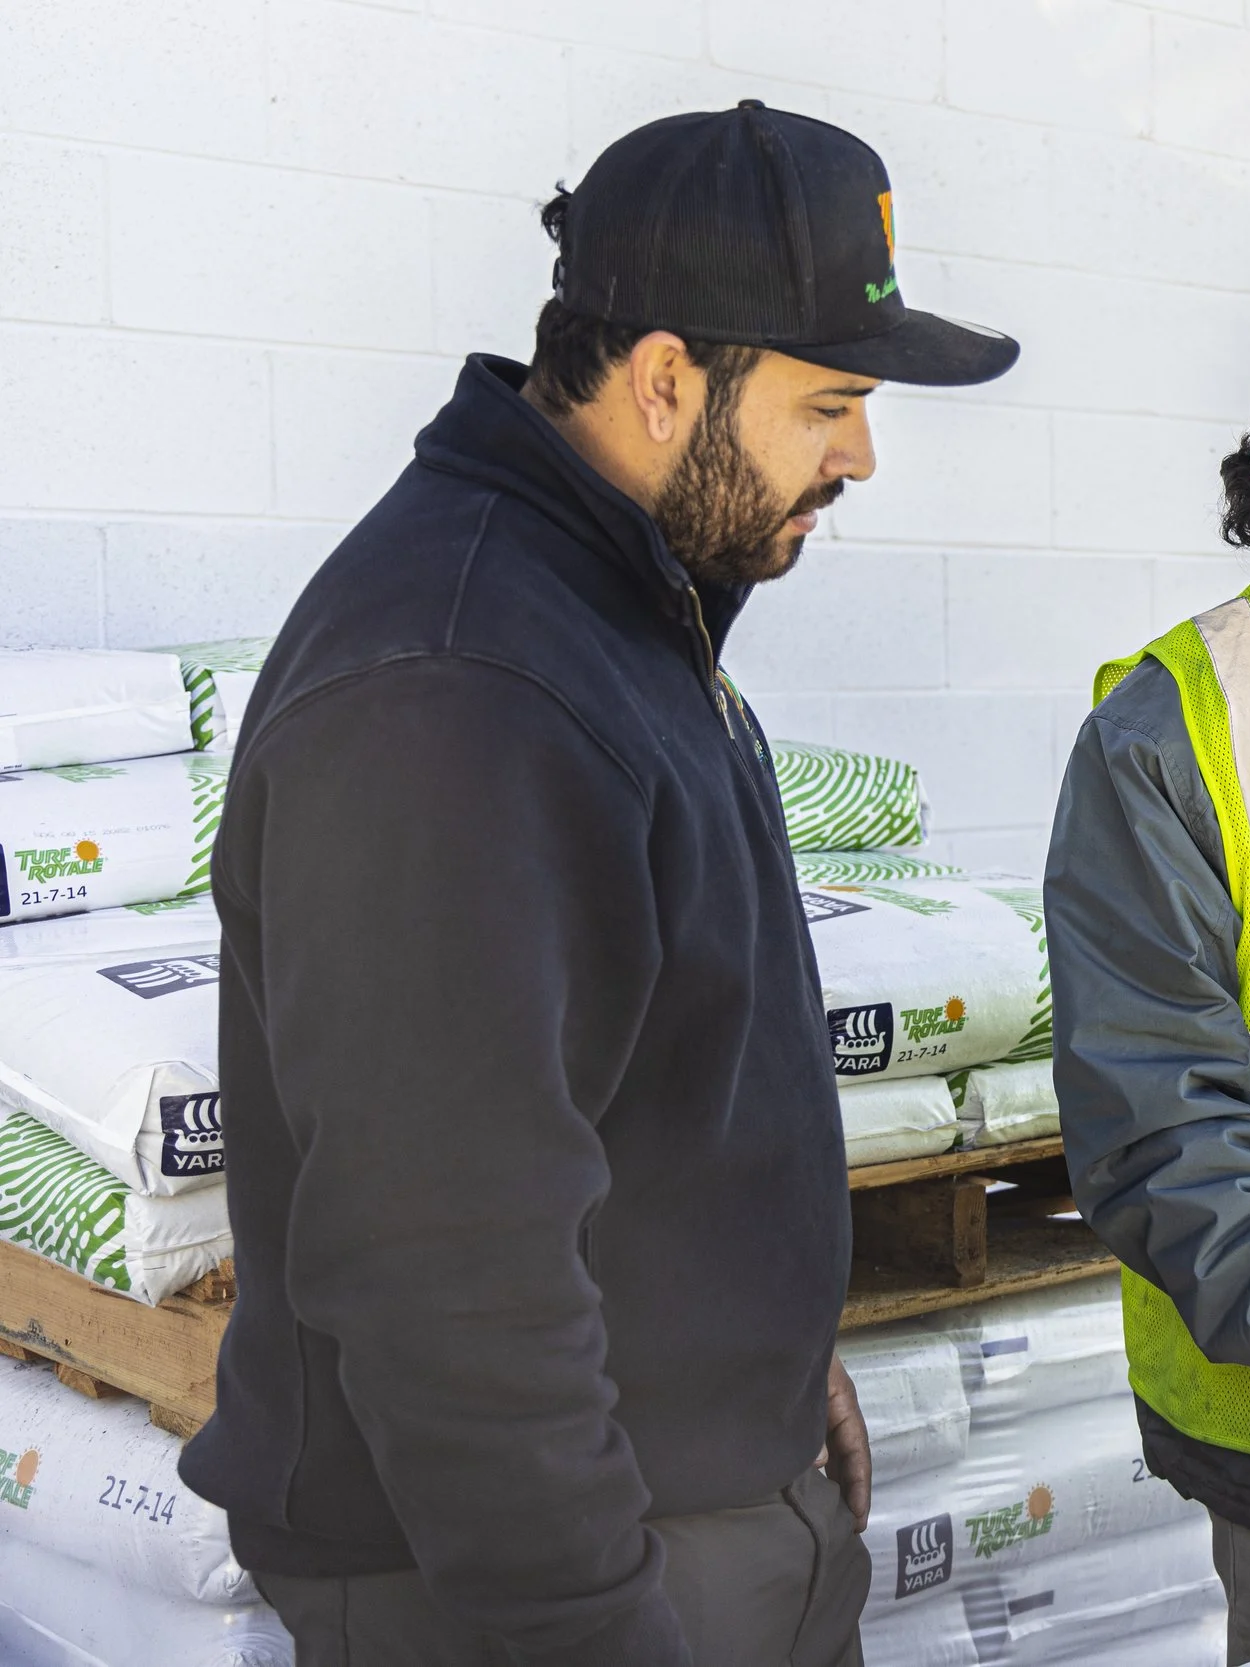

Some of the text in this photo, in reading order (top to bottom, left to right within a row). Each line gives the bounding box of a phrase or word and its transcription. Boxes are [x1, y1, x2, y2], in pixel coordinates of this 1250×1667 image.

[15, 847, 72, 872] TURF
[28, 857, 104, 884] ROYALE
[21, 885, 87, 906] 21-7-14
[900, 1006, 944, 1031] TURF
[907, 1017, 966, 1043] ROYALE
[833, 1055, 881, 1070] YARA
[897, 1043, 947, 1063] 21-7-14
[173, 1153, 226, 1170] YAR
[99, 1475, 177, 1526] 21-7-14
[965, 1500, 1024, 1547] TURF
[975, 1512, 1055, 1560] ROYALE
[904, 1566, 945, 1592] YARA
